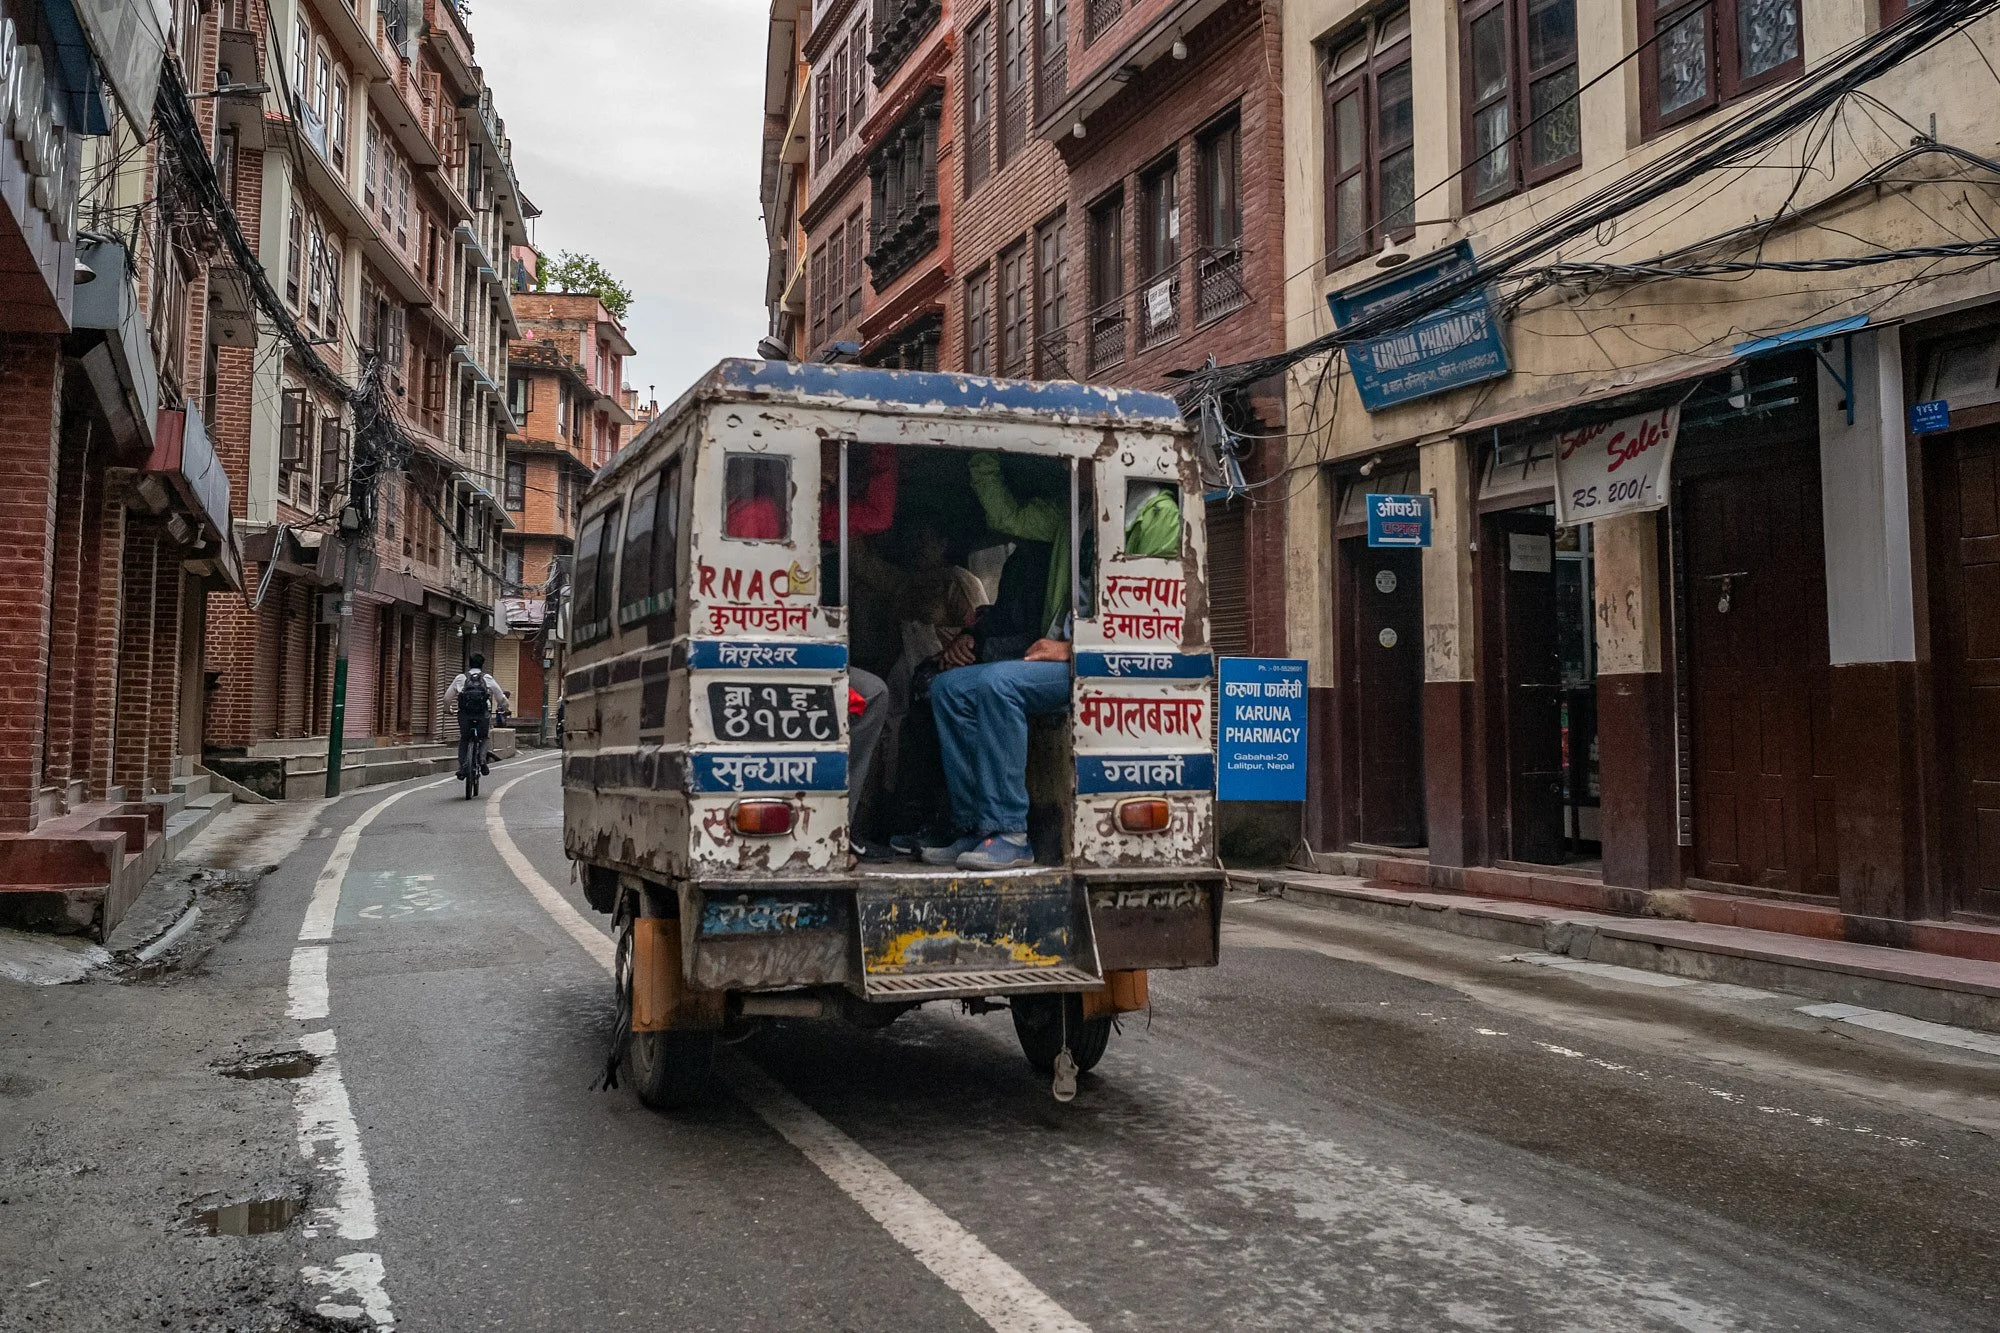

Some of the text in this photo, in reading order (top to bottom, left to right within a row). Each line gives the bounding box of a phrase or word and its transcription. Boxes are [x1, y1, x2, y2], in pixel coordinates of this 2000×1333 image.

[1371, 333, 1420, 373] KARUNA
[1418, 308, 1488, 359] PHARMACY
[1607, 407, 1669, 473] Sale!
[1608, 474, 1652, 503] 200/-
[1376, 497, 1422, 517] औषधी
[1235, 705, 1292, 721] KARUNA
[1225, 727, 1301, 743] PHARMACY
[1227, 762, 1295, 771] Lalitpur, Nepal
